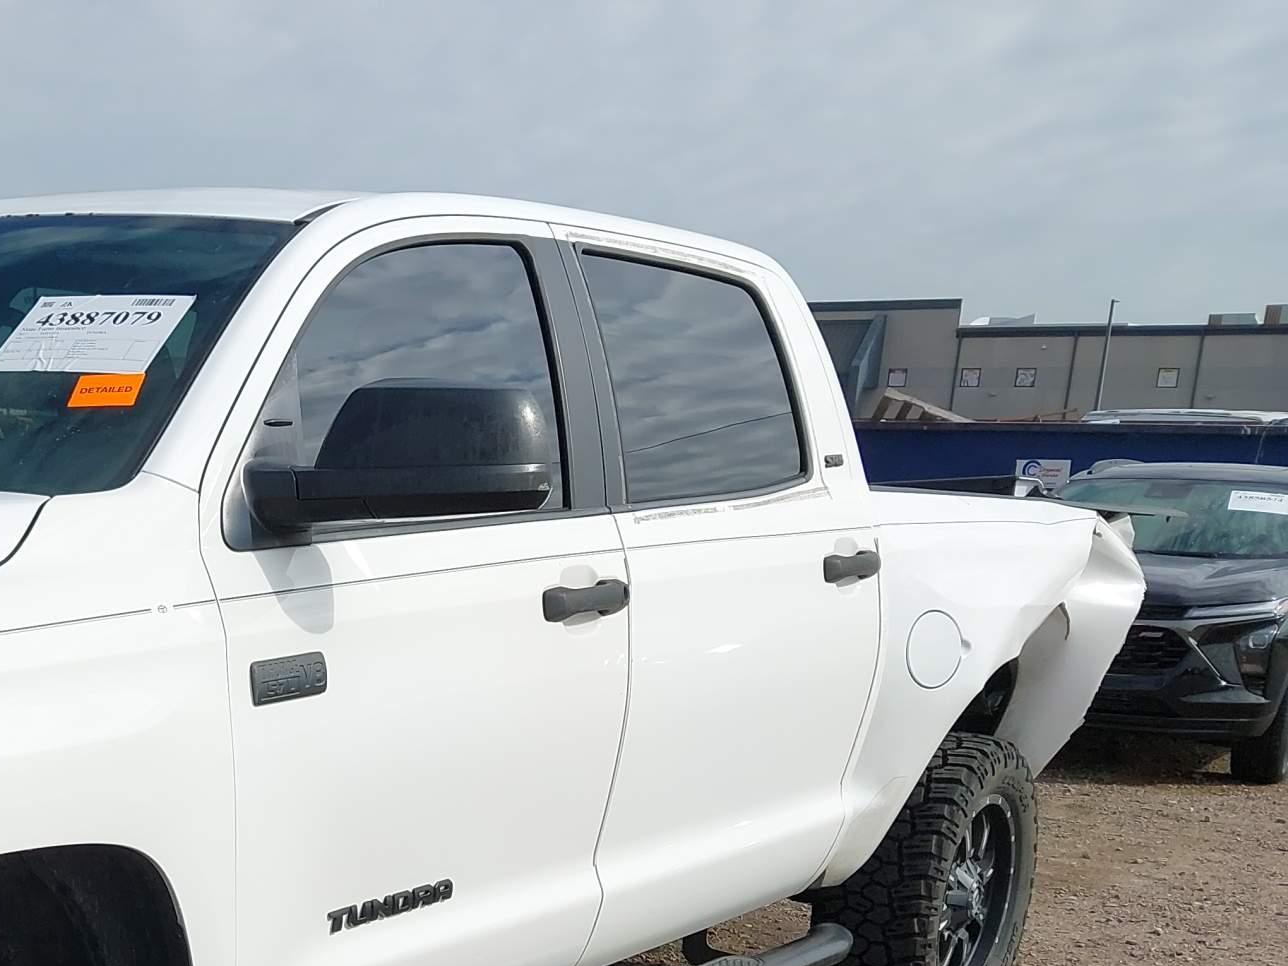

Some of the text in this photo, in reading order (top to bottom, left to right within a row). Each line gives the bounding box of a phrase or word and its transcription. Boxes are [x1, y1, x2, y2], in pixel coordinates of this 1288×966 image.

[36, 310, 162, 327] 43887079
[79, 385, 133, 395] DETAILED
[327, 878, 453, 936] TUNDRA
